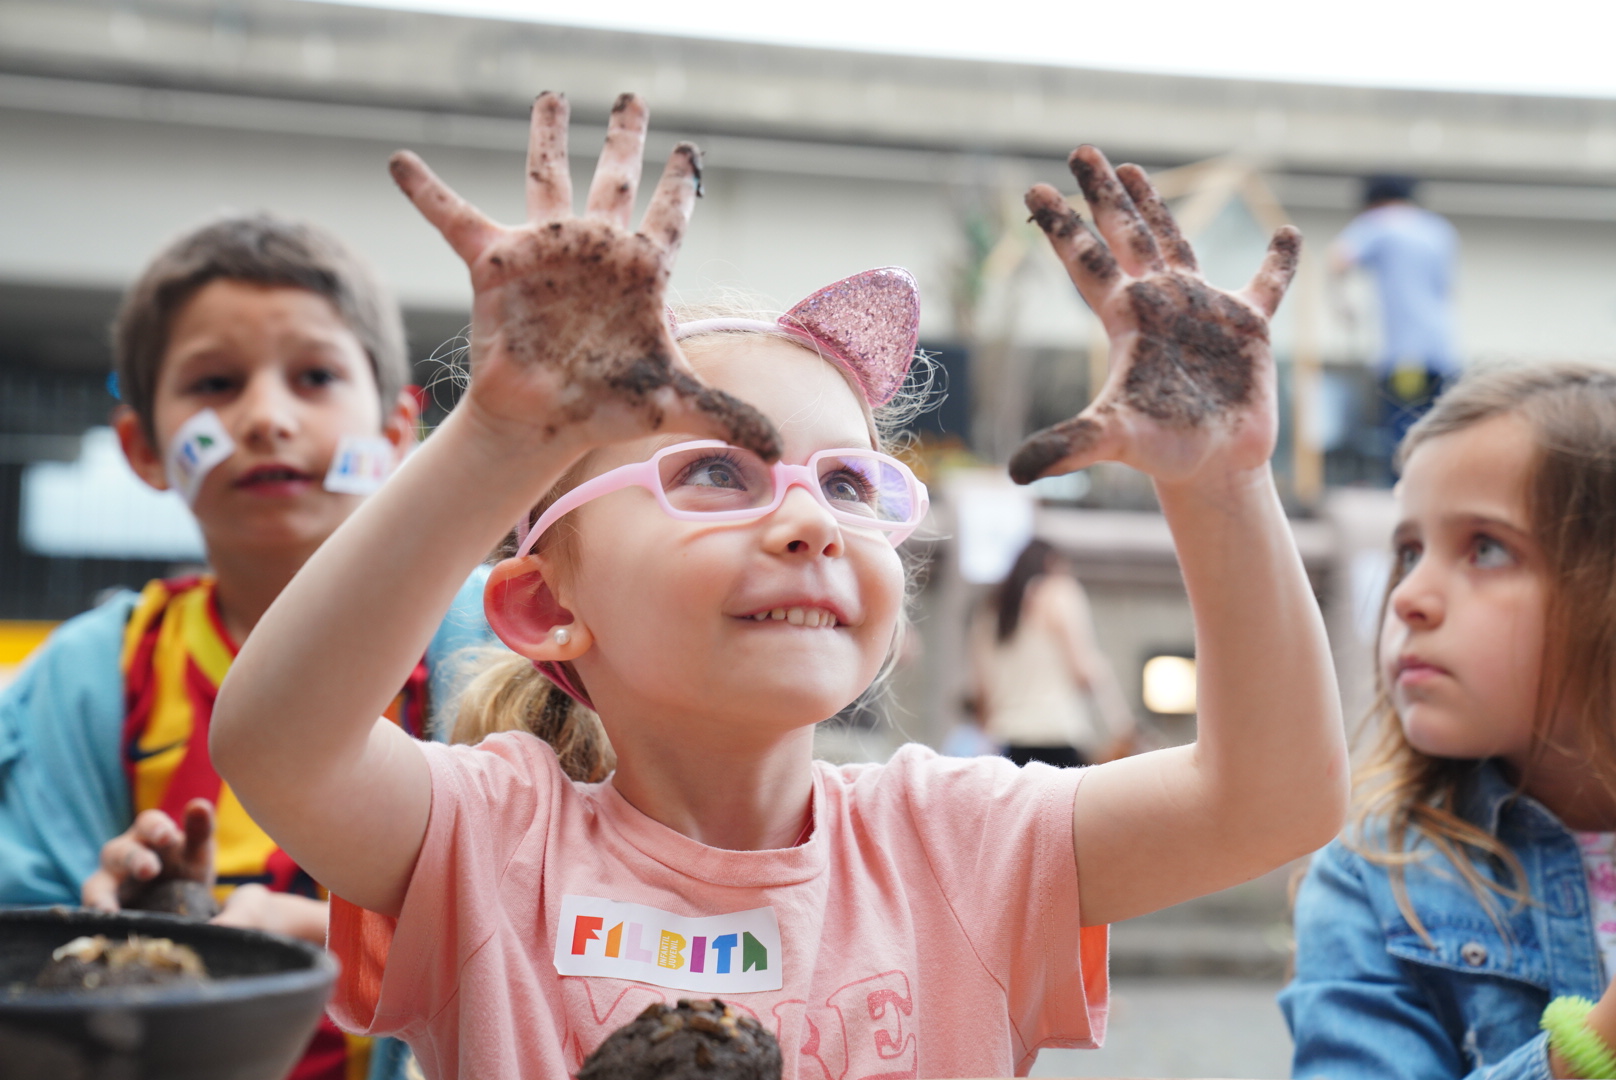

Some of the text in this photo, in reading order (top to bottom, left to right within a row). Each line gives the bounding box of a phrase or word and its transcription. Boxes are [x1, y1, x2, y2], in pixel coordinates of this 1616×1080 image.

[571, 915, 768, 974] FILBITA
[658, 935, 670, 967] INFANTIL
[667, 939, 679, 969] JUVENIL
